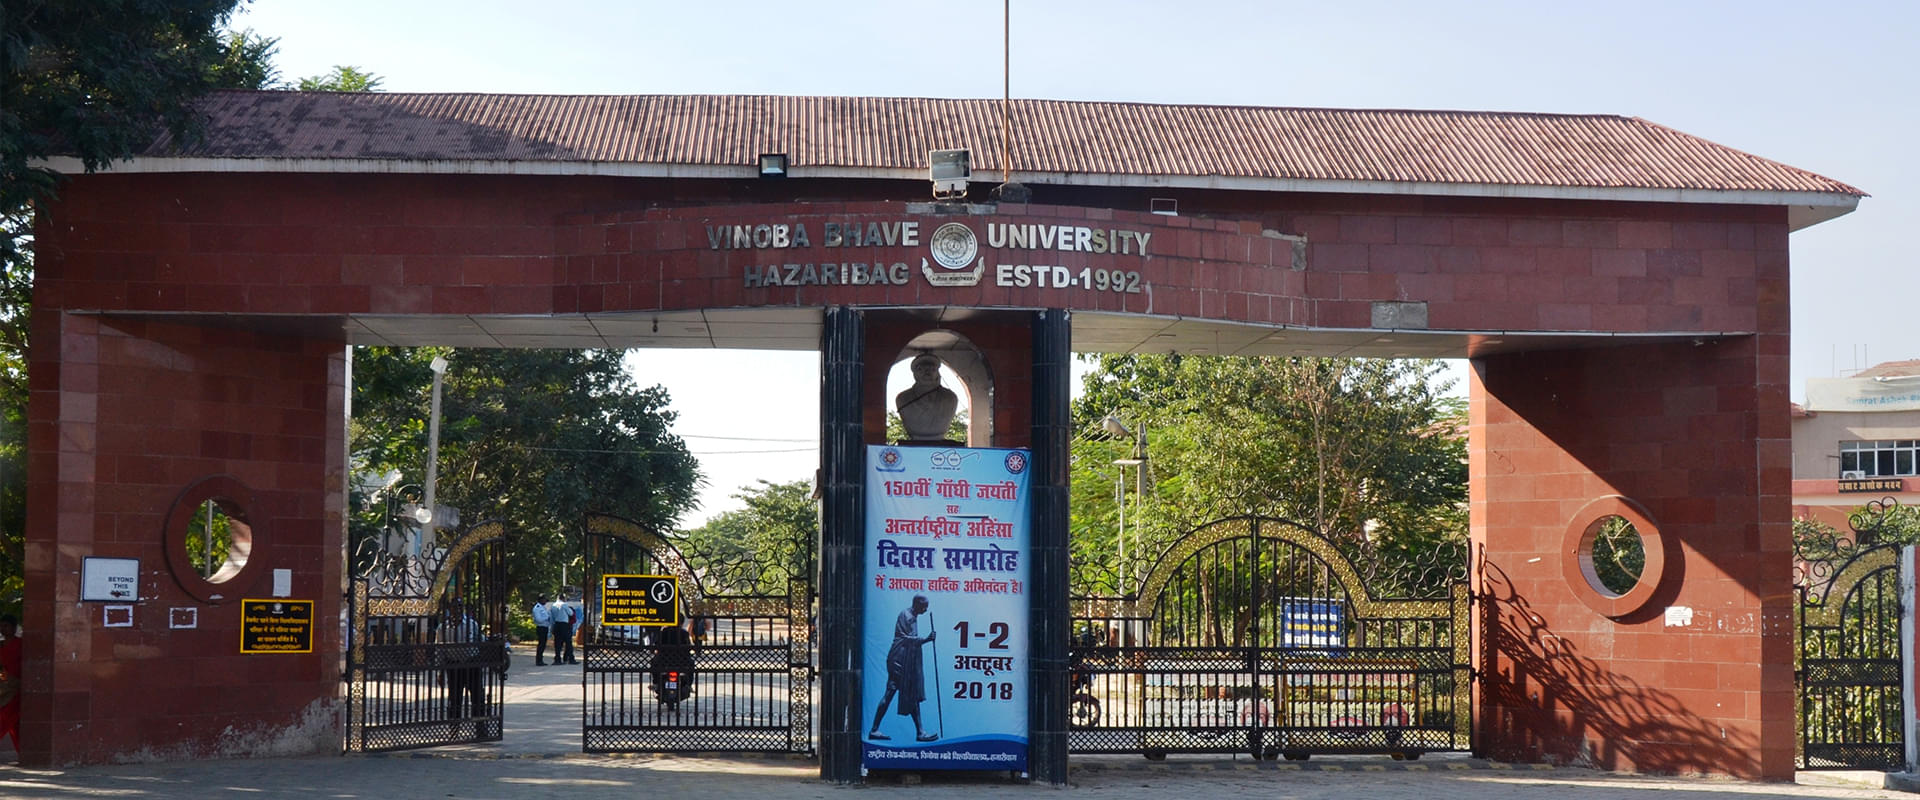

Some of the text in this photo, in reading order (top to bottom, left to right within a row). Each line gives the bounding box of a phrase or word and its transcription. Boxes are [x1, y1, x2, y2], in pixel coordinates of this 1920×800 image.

[706, 223, 811, 249] VINOBA
[824, 221, 920, 248] BHAVE
[987, 223, 1151, 257] UNIVERSITY
[744, 262, 910, 288] HAZARIBAG
[884, 477, 932, 498] 150वीं
[976, 480, 1018, 501] जयंती
[946, 504, 960, 514] सह
[967, 517, 1013, 539] अहिंसा
[876, 539, 1019, 571] दिवस समारोह
[875, 574, 886, 589] में
[889, 577, 923, 591] आपका
[928, 576, 960, 592] हार्दिक
[953, 621, 1010, 650] 1-2
[953, 655, 1014, 676] अक्टूबर
[953, 681, 1013, 700] 2018
